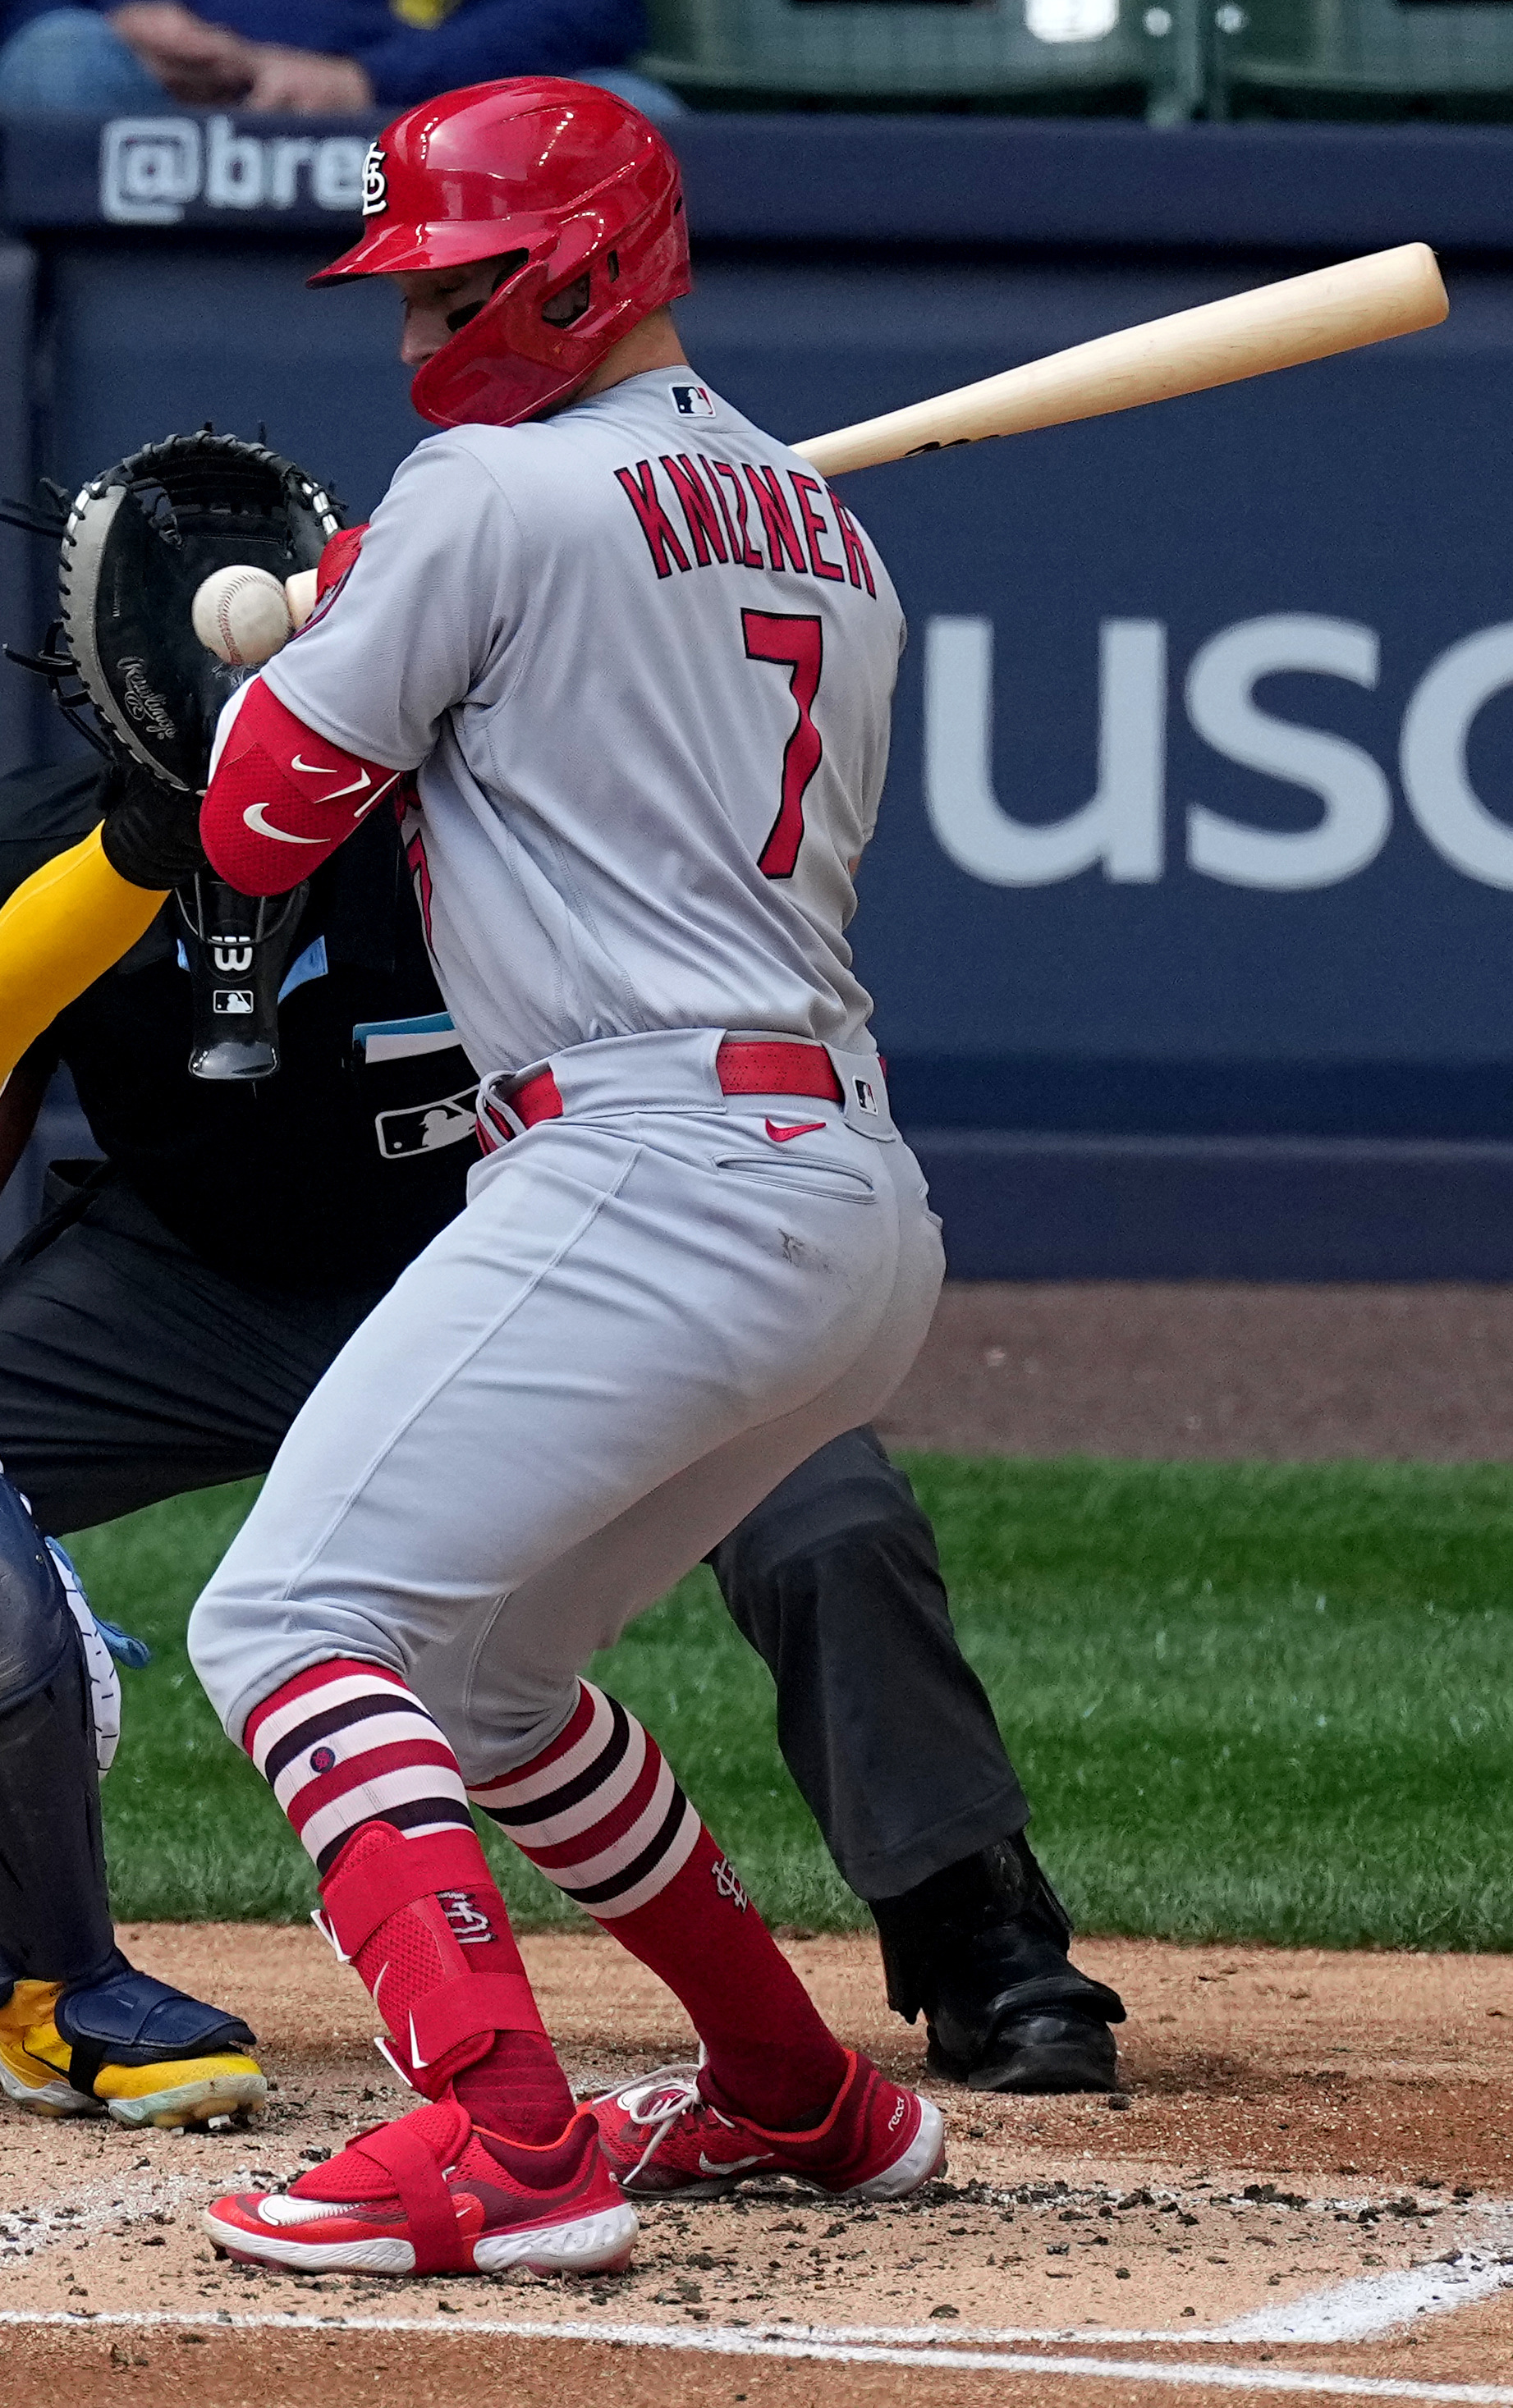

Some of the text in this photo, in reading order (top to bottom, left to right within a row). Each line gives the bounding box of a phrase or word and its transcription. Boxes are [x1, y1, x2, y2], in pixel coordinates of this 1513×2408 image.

[613, 453, 877, 601] KNIZNER
[117, 656, 177, 739] Rawlings
[740, 607, 823, 879] 7
